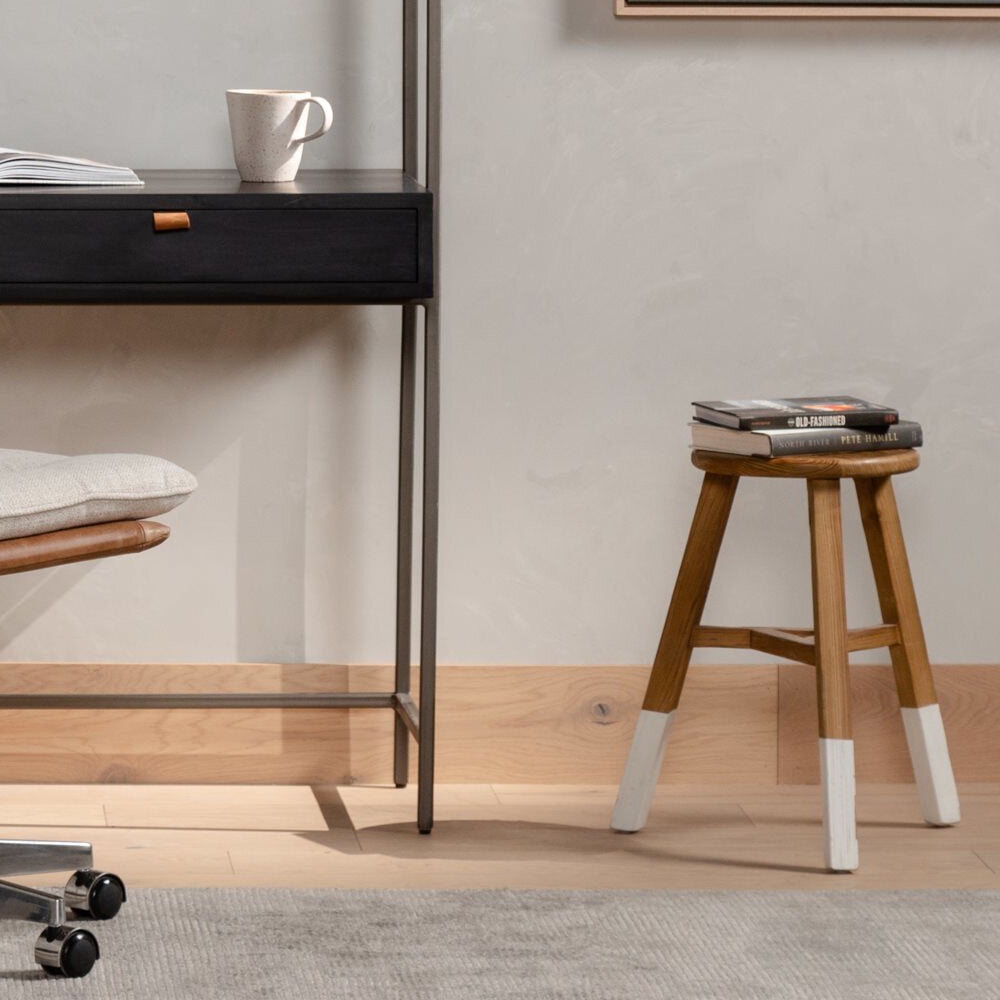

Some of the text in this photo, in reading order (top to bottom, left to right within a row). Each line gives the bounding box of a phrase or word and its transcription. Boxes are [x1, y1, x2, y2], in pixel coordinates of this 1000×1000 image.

[795, 415, 846, 427] OLD-FASHIONED
[779, 440, 804, 448] NORTH
[841, 434, 861, 445] PETE
[865, 432, 899, 443] HAMILL
